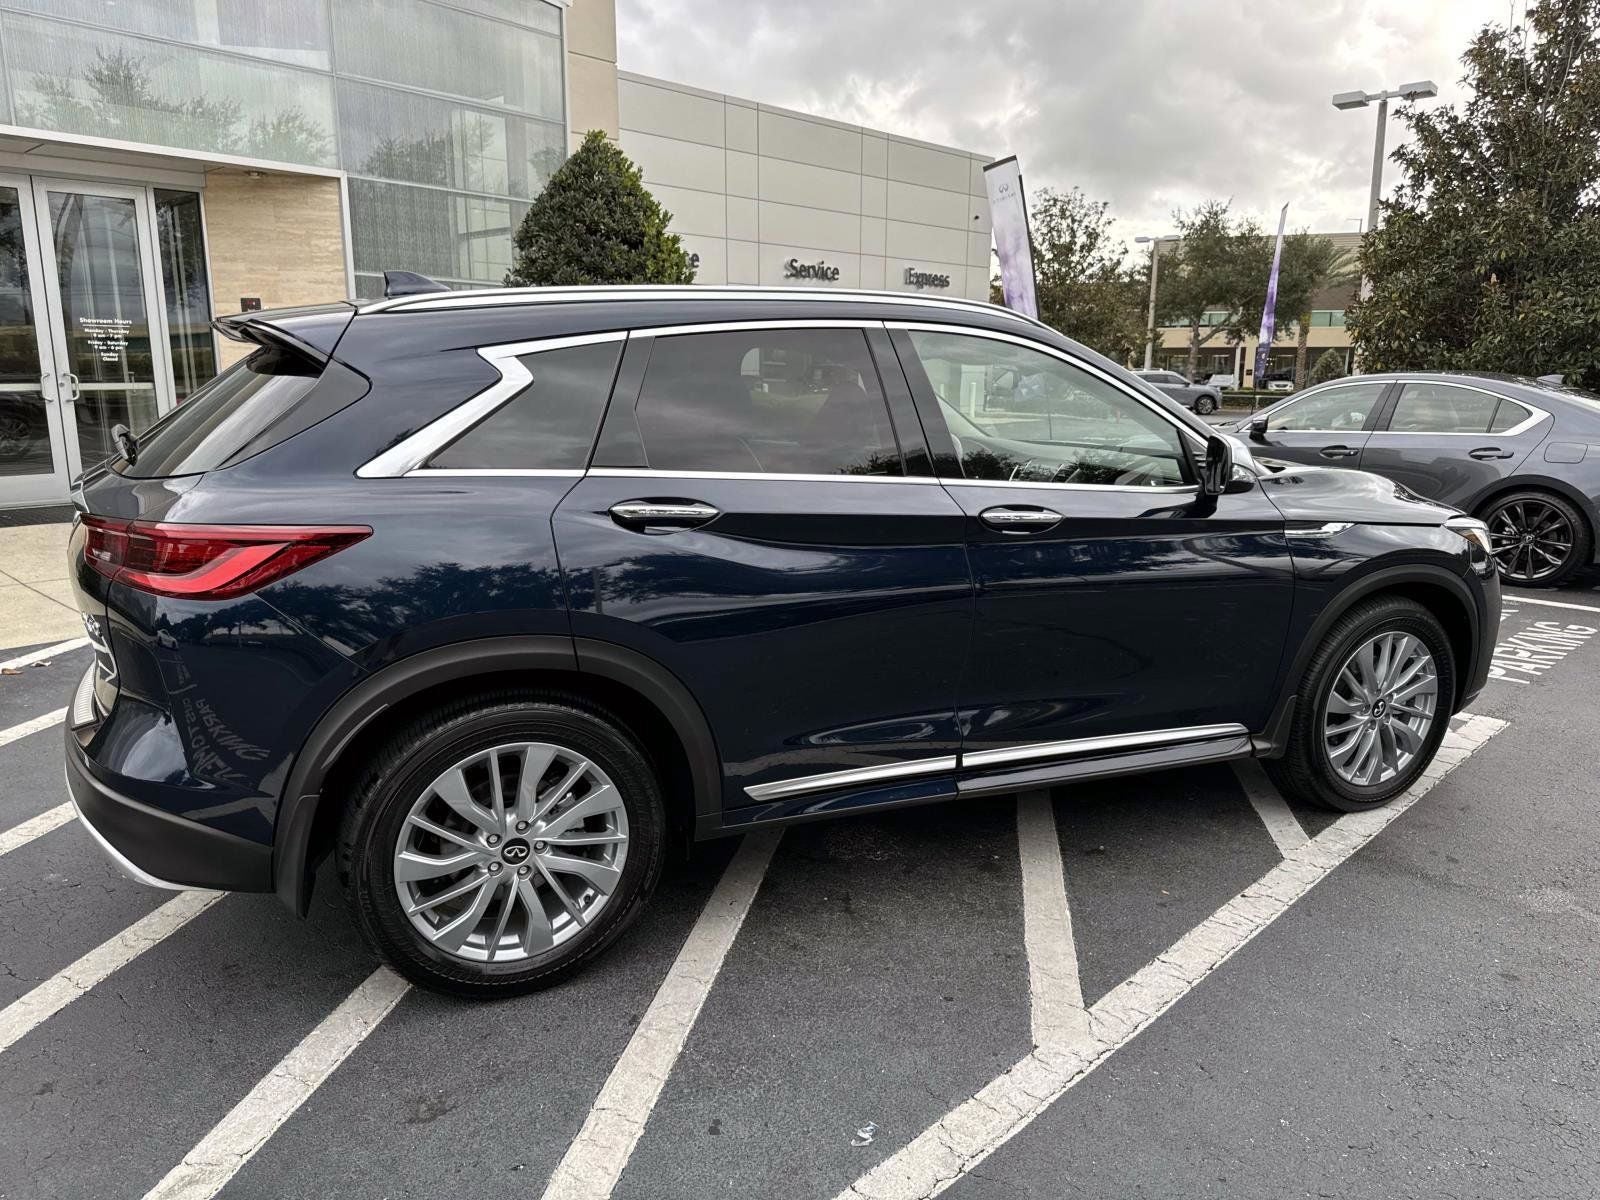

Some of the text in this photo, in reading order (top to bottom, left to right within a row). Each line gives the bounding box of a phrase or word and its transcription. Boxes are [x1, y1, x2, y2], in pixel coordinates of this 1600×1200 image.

[784, 258, 840, 281] Service
[904, 267, 950, 290] Express
[1487, 621, 1598, 684] PARKING
